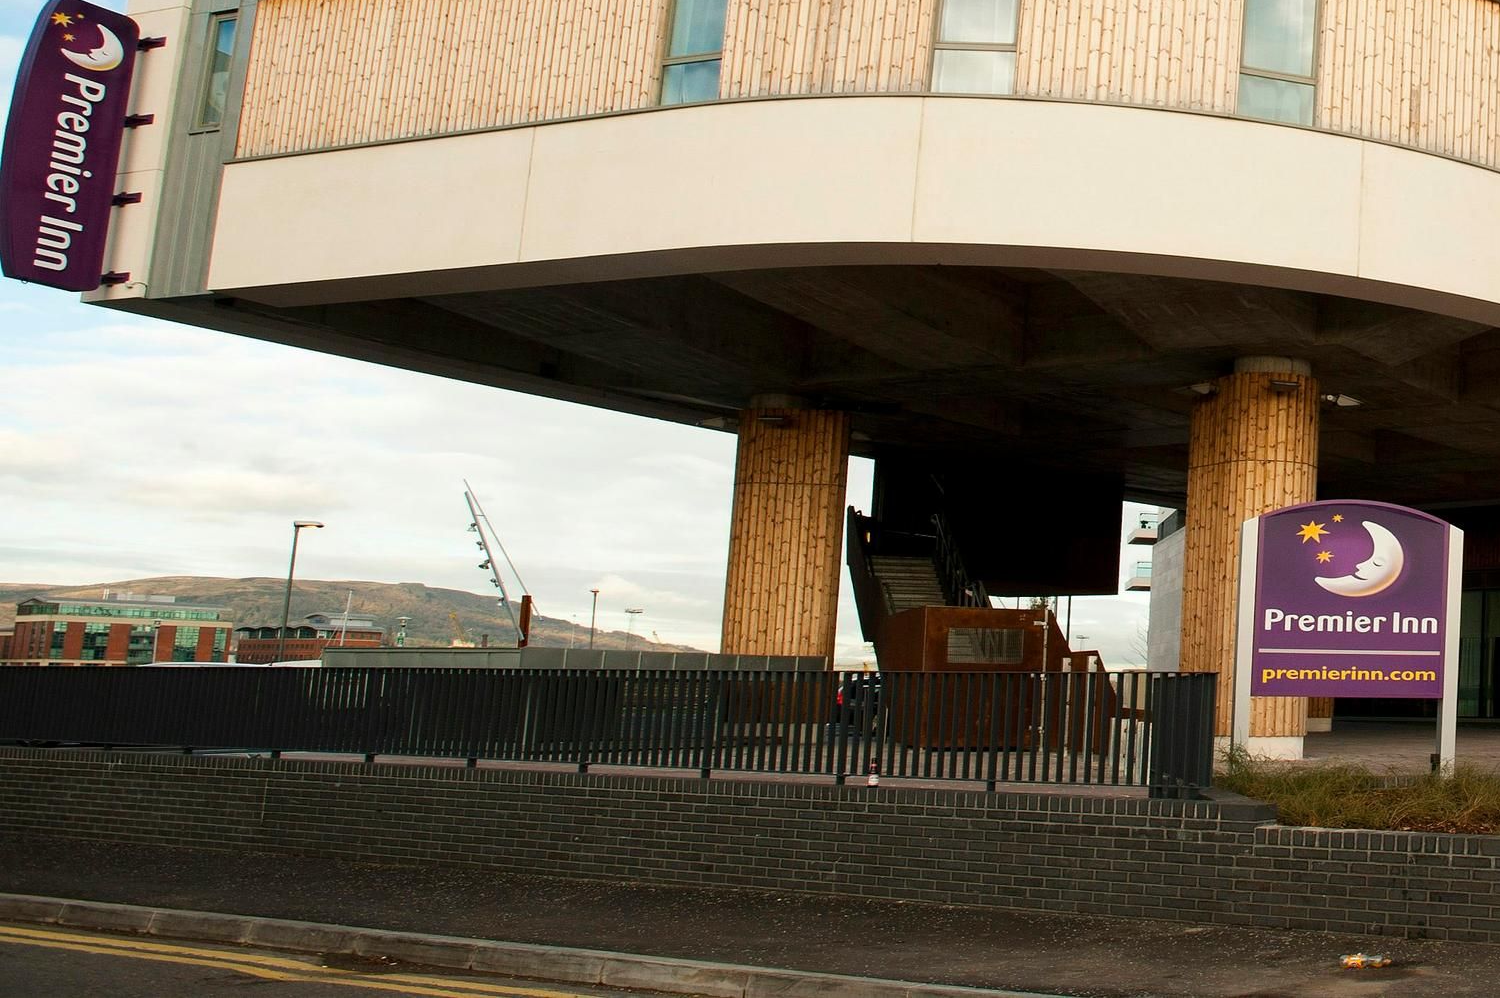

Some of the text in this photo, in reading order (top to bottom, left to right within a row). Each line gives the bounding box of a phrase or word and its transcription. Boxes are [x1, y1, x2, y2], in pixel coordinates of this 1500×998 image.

[33, 72, 106, 272] Premier Inn
[1264, 608, 1438, 634] Premier Inn
[1262, 665, 1436, 683] premierinn.com
